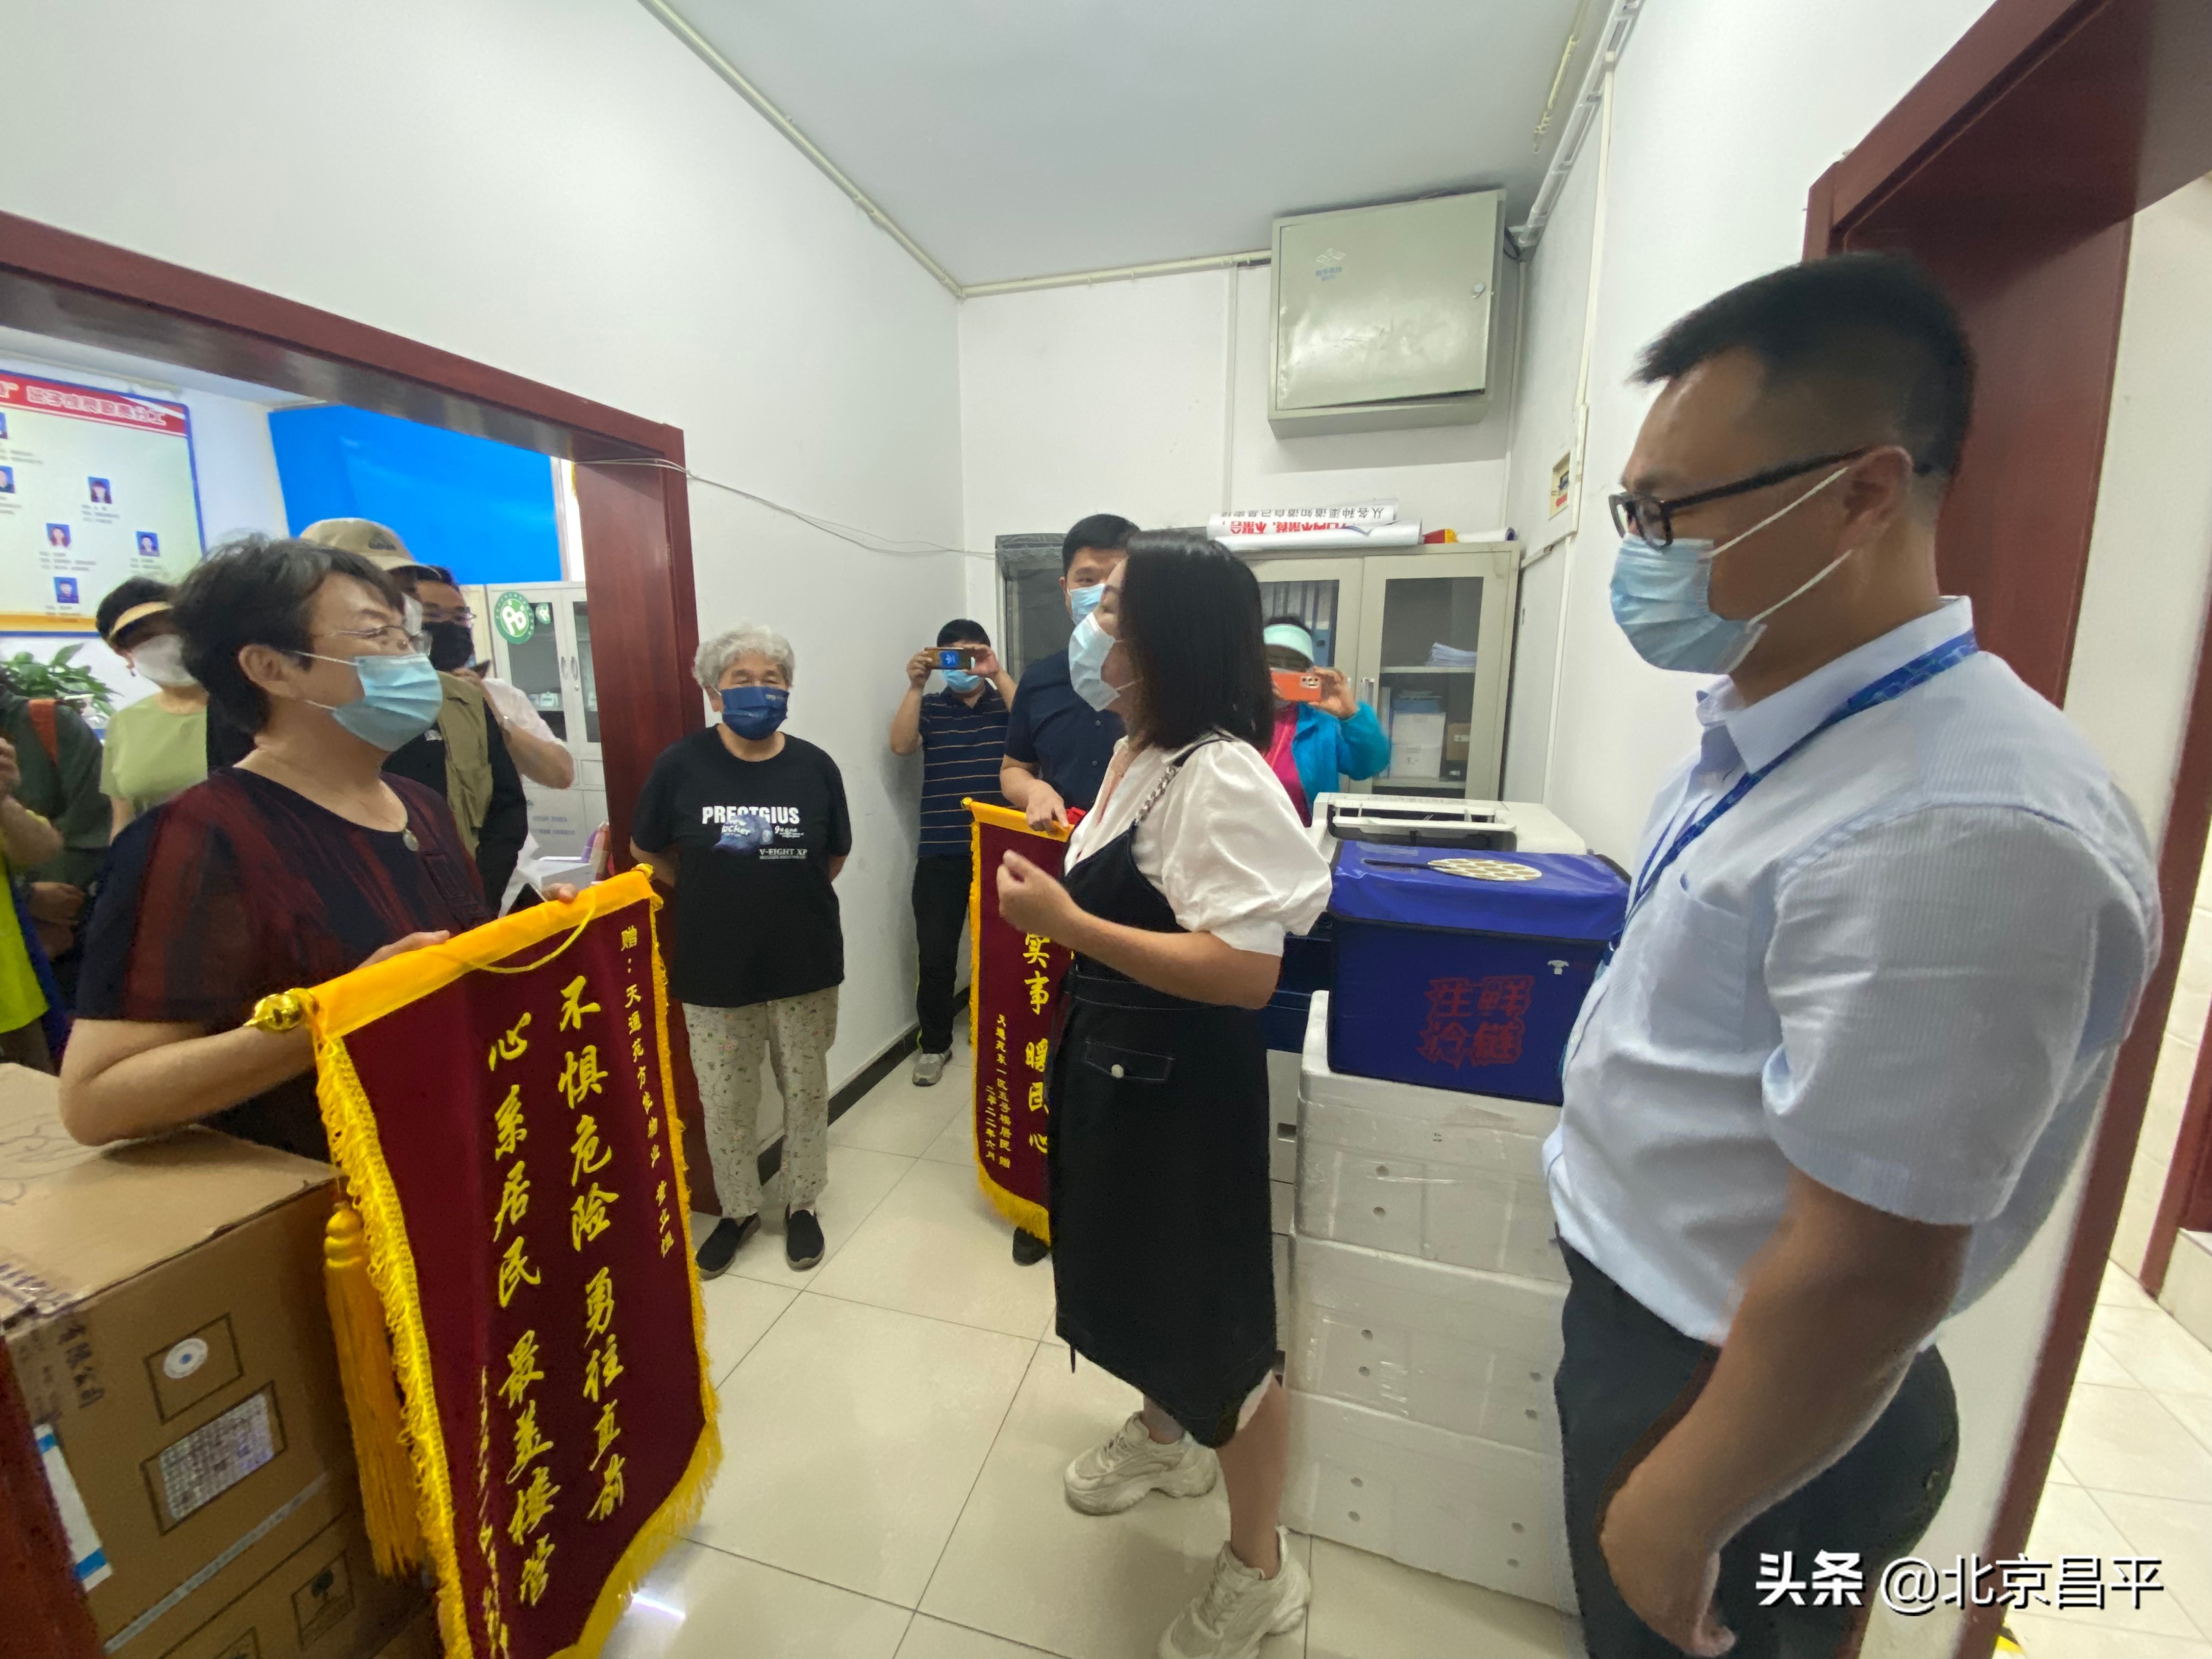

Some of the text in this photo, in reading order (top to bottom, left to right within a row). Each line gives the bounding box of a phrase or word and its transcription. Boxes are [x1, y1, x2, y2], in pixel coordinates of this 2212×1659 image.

[487, 1012, 541, 1308] 心系居民
[557, 975, 619, 1252] 不惧危险
